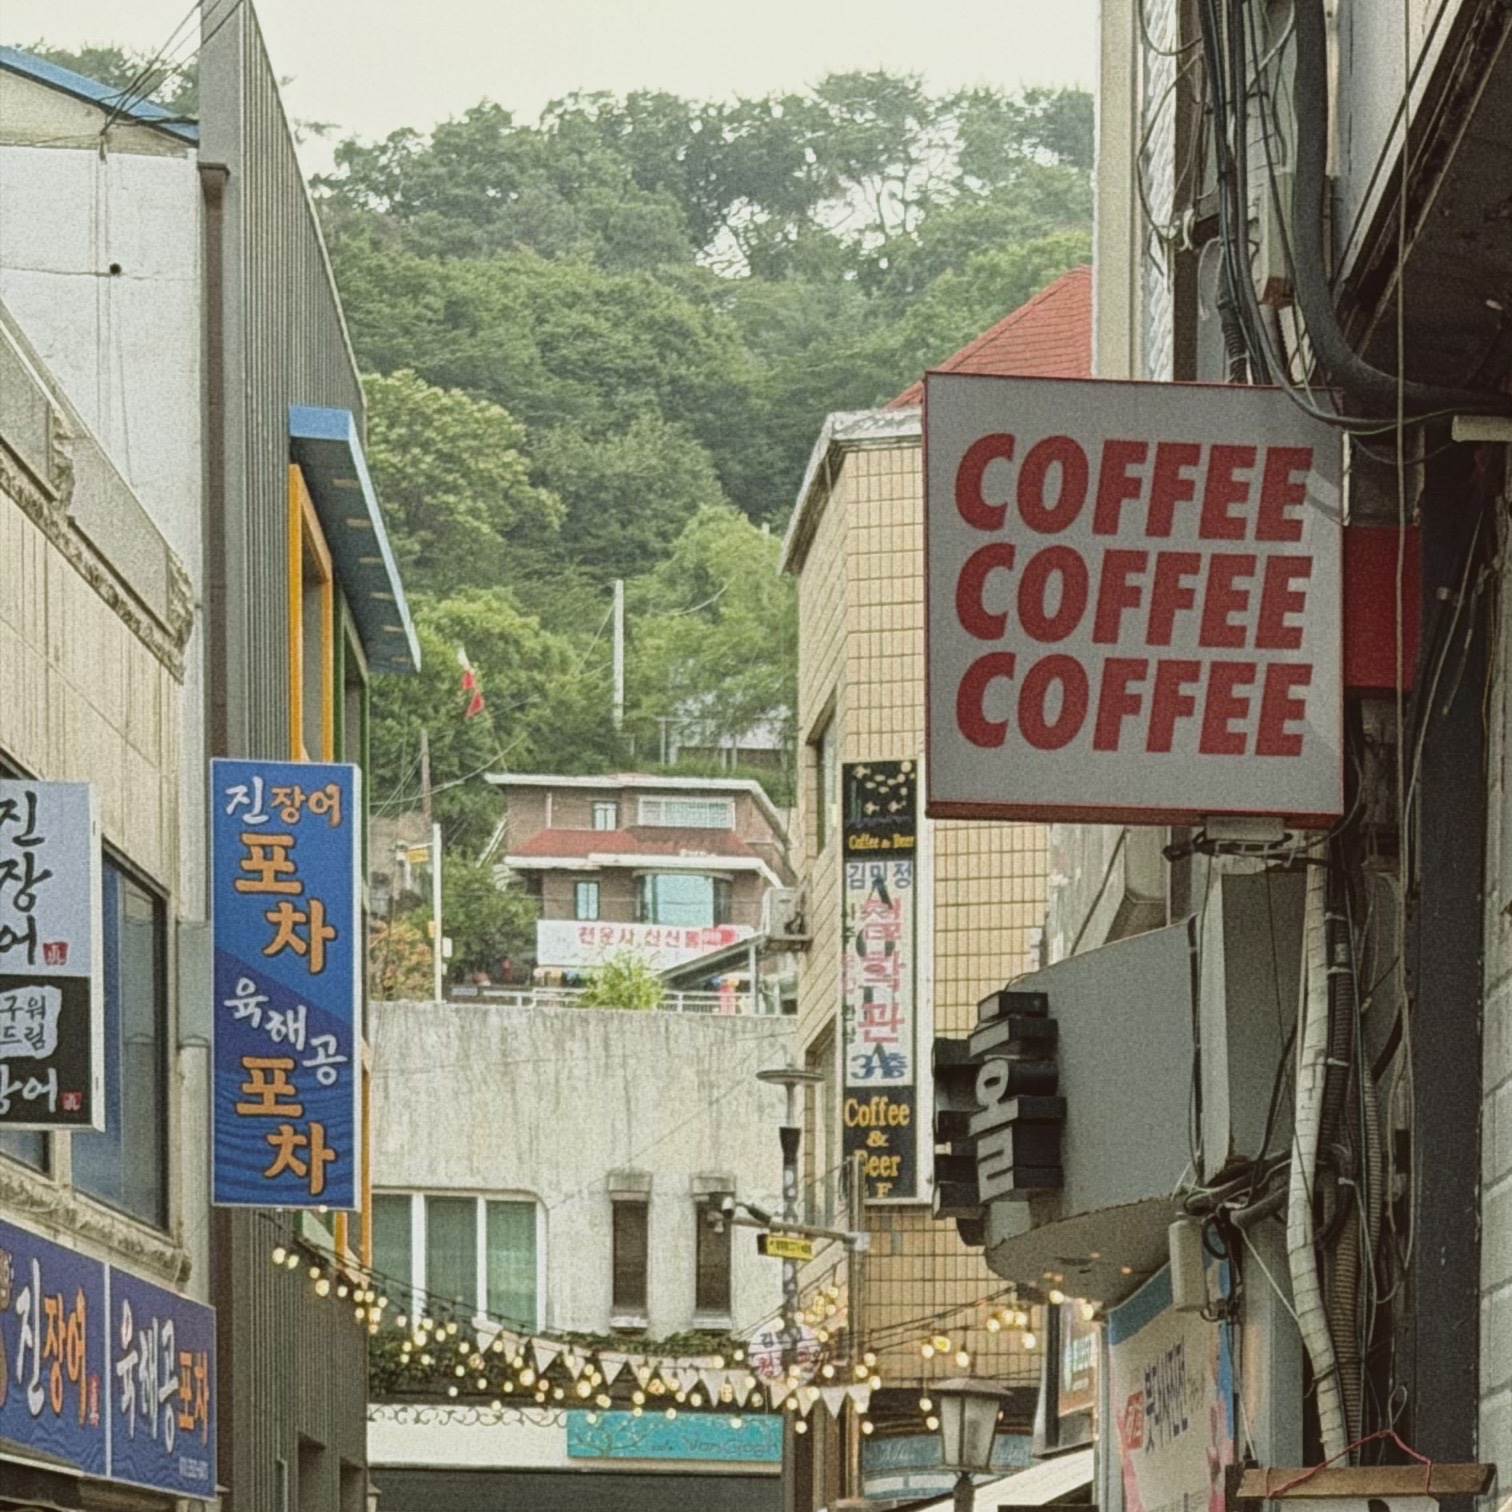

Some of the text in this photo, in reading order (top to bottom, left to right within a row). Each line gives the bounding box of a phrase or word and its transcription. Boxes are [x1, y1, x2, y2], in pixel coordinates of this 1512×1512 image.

[955, 432, 1314, 542] COFFEE
[955, 542, 1313, 650] COFFEE
[955, 651, 1313, 757] COFFEE
[225, 777, 342, 828] 진장어
[234, 832, 337, 974] 포차
[224, 977, 348, 1085] 육해공
[234, 1056, 338, 1195] 포차
[844, 1096, 910, 1127] Coffee
[866, 1130, 890, 1148] &
[16, 1258, 87, 1427] 진장어
